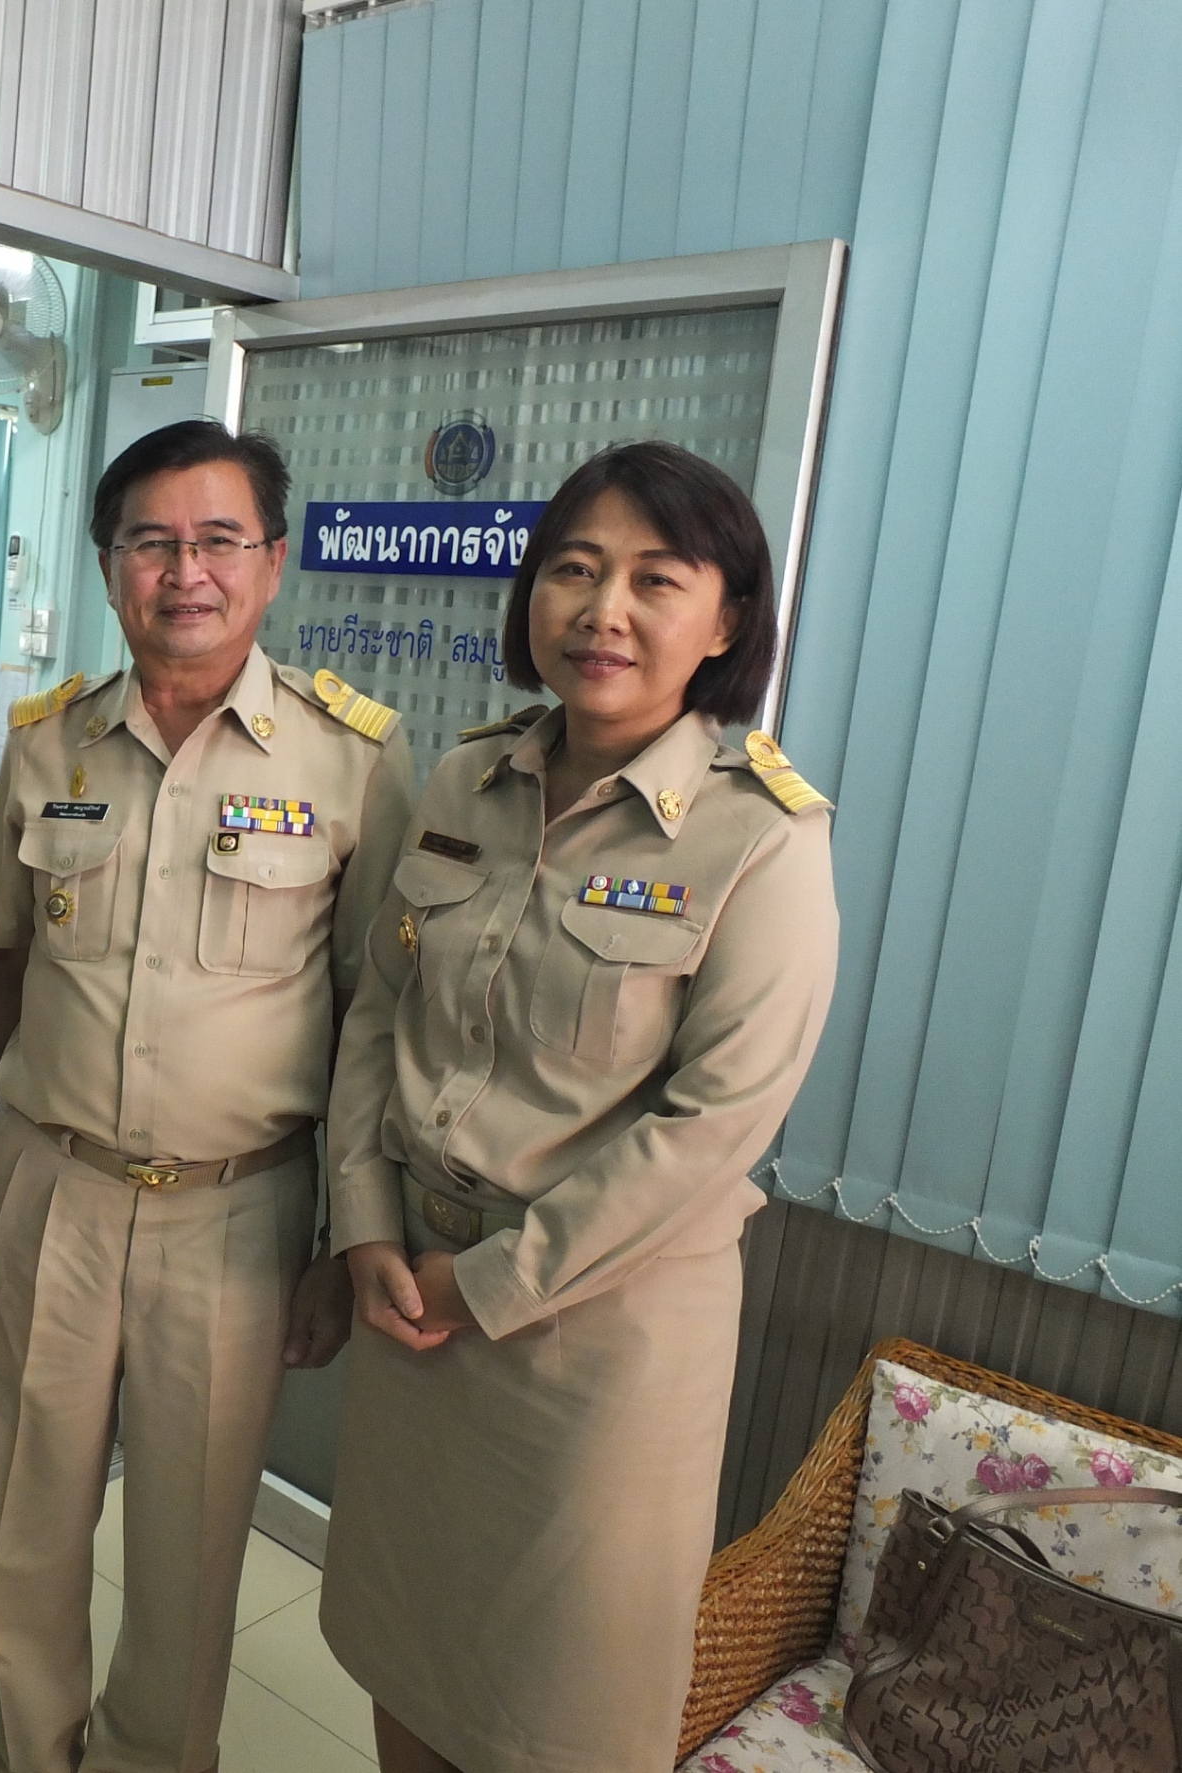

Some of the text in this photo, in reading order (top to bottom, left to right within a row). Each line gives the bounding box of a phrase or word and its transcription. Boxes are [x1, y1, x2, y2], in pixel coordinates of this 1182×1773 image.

[298, 613, 434, 660] นายวีระชาติ
